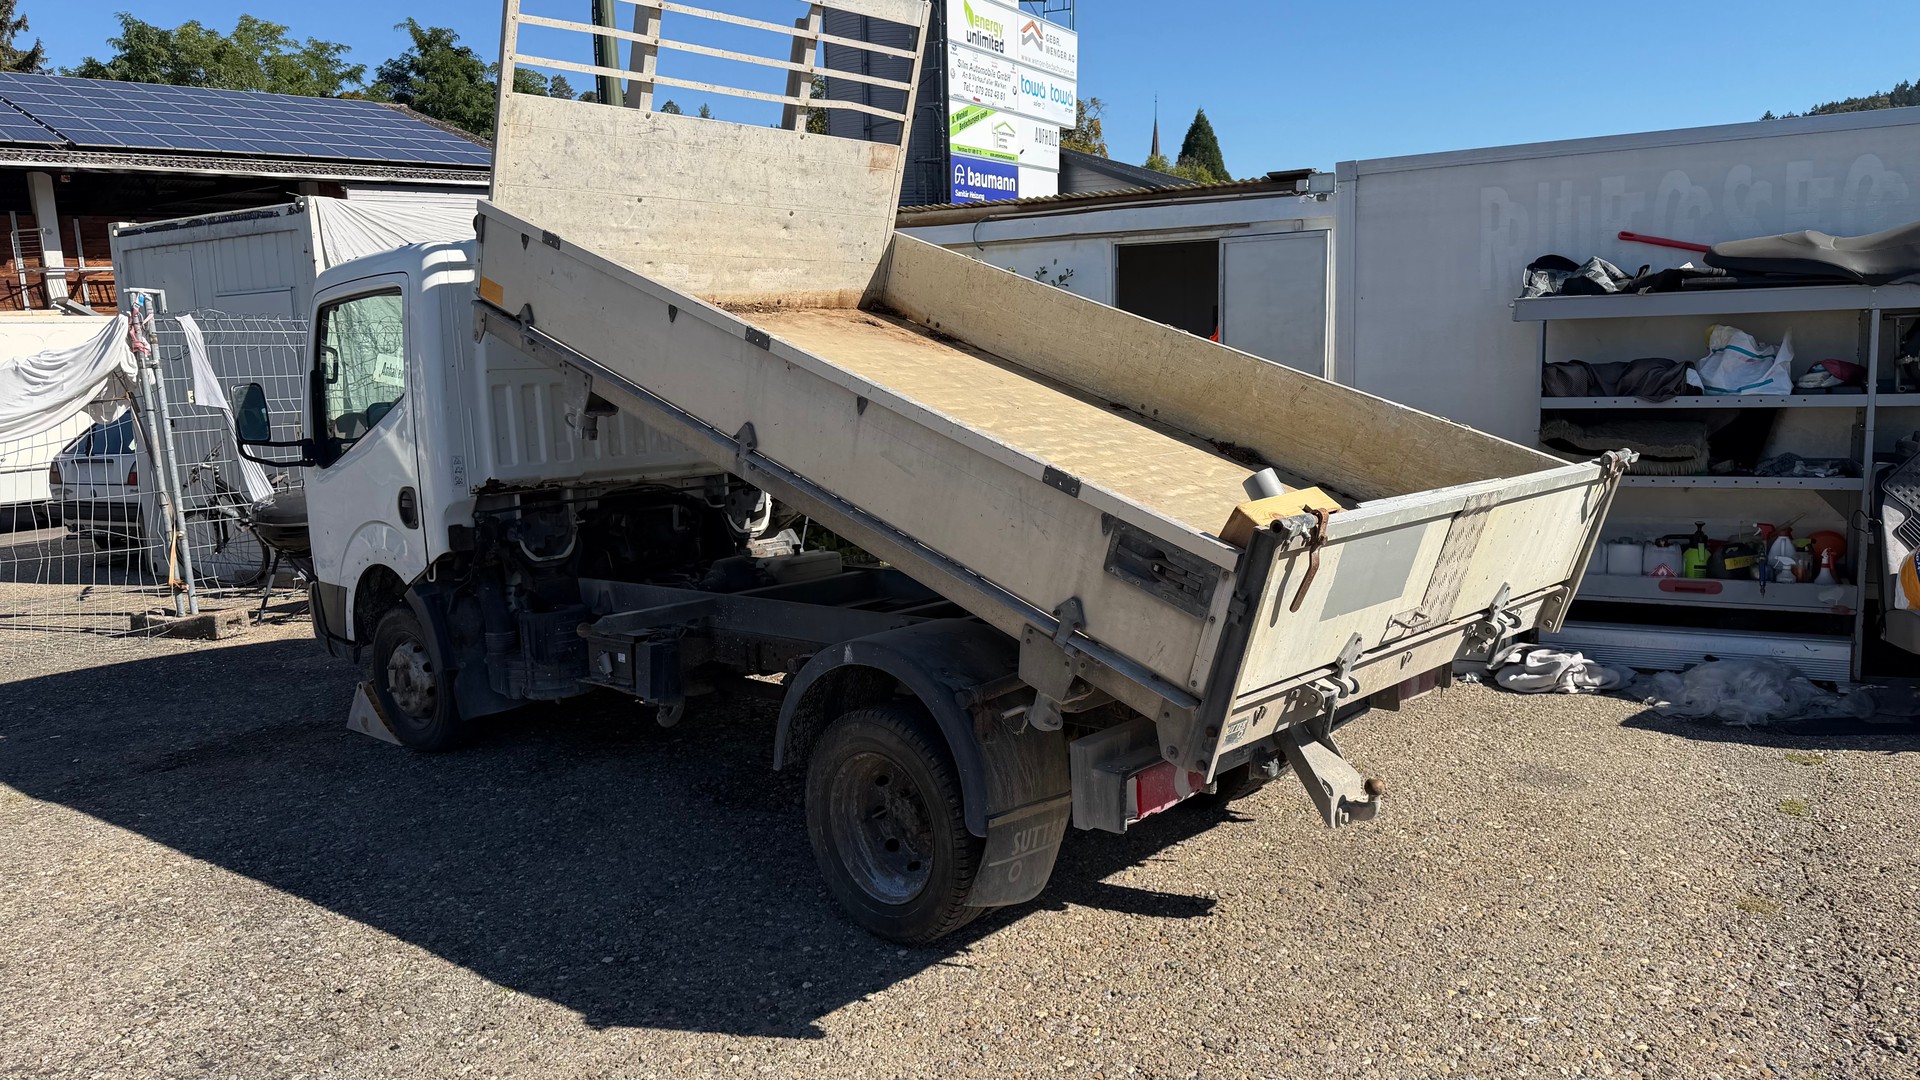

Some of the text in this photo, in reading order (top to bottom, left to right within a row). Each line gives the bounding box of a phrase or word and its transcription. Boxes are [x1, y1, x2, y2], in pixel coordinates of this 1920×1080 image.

[975, 15, 1003, 39] energy
[966, 30, 1004, 54] unlimited
[969, 62, 996, 79] Automobile
[967, 166, 1016, 192] baumann
